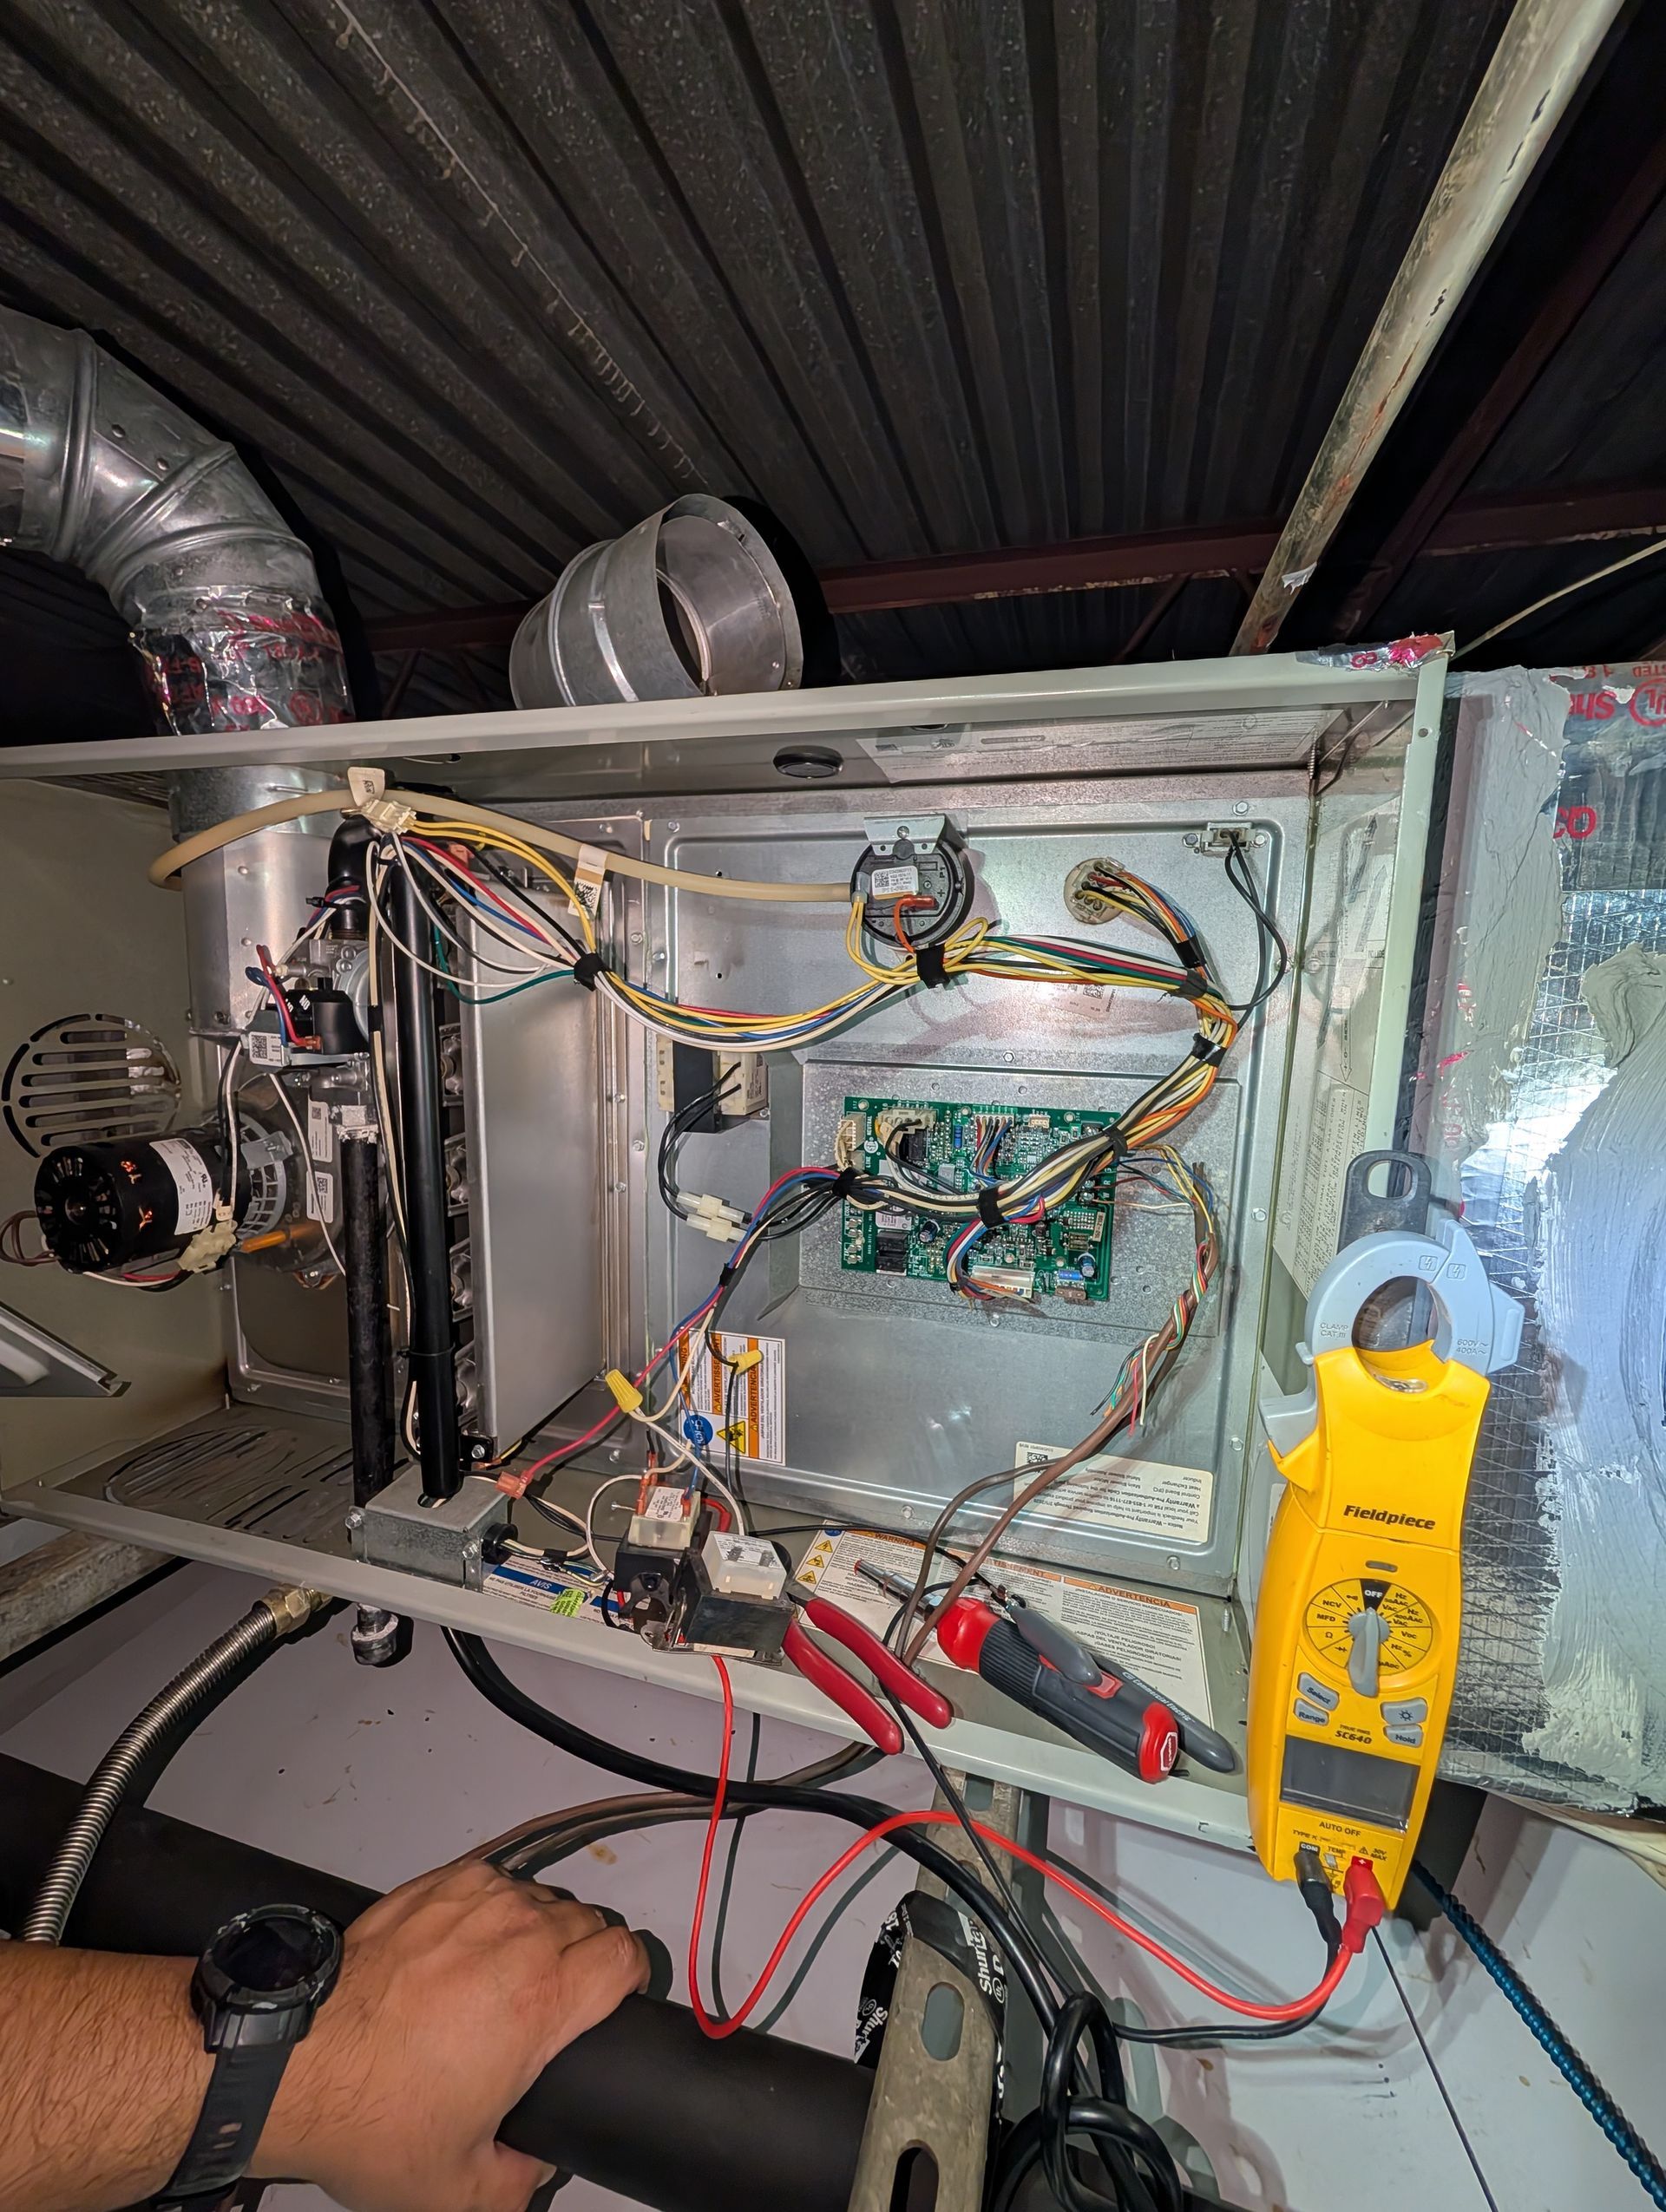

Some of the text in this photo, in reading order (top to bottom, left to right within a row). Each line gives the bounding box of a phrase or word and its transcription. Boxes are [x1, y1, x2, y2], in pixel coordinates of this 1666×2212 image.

[1161, 1479, 1187, 1489] Exchanger
[1120, 1490, 1164, 1502] Pre-Authorization
[1053, 1501, 1072, 1509] Through
[1165, 1497, 1196, 1508] Warranty
[1094, 1508, 1134, 1520] Pre-Authorization
[1131, 1507, 1157, 1515] important
[1135, 1515, 1163, 1525] Warranty
[1342, 1504, 1436, 1531] Fieldpiece
[874, 1533, 915, 1547] WARNING
[530, 1579, 552, 1589] AVIS
[1098, 1585, 1171, 1607] ADVERTENCIA
[1364, 1589, 1382, 1598] OFF
[1106, 1639, 1144, 1651] VENTILADOR
[1132, 1675, 1168, 1707] Commercial
[1166, 1700, 1191, 1724] Electric
[1305, 1686, 1332, 1705] Select
[1297, 1711, 1326, 1724] Range
[1334, 1729, 1373, 1744] SC640
[1394, 1733, 1417, 1744] Hold
[1292, 1829, 1309, 1838] TYPE
[1318, 1821, 1361, 1836] AUTO OFF
[1300, 1842, 1319, 1852] COM
[1327, 1845, 1346, 1855] TEMP
[1370, 1852, 1387, 1861] MAX
